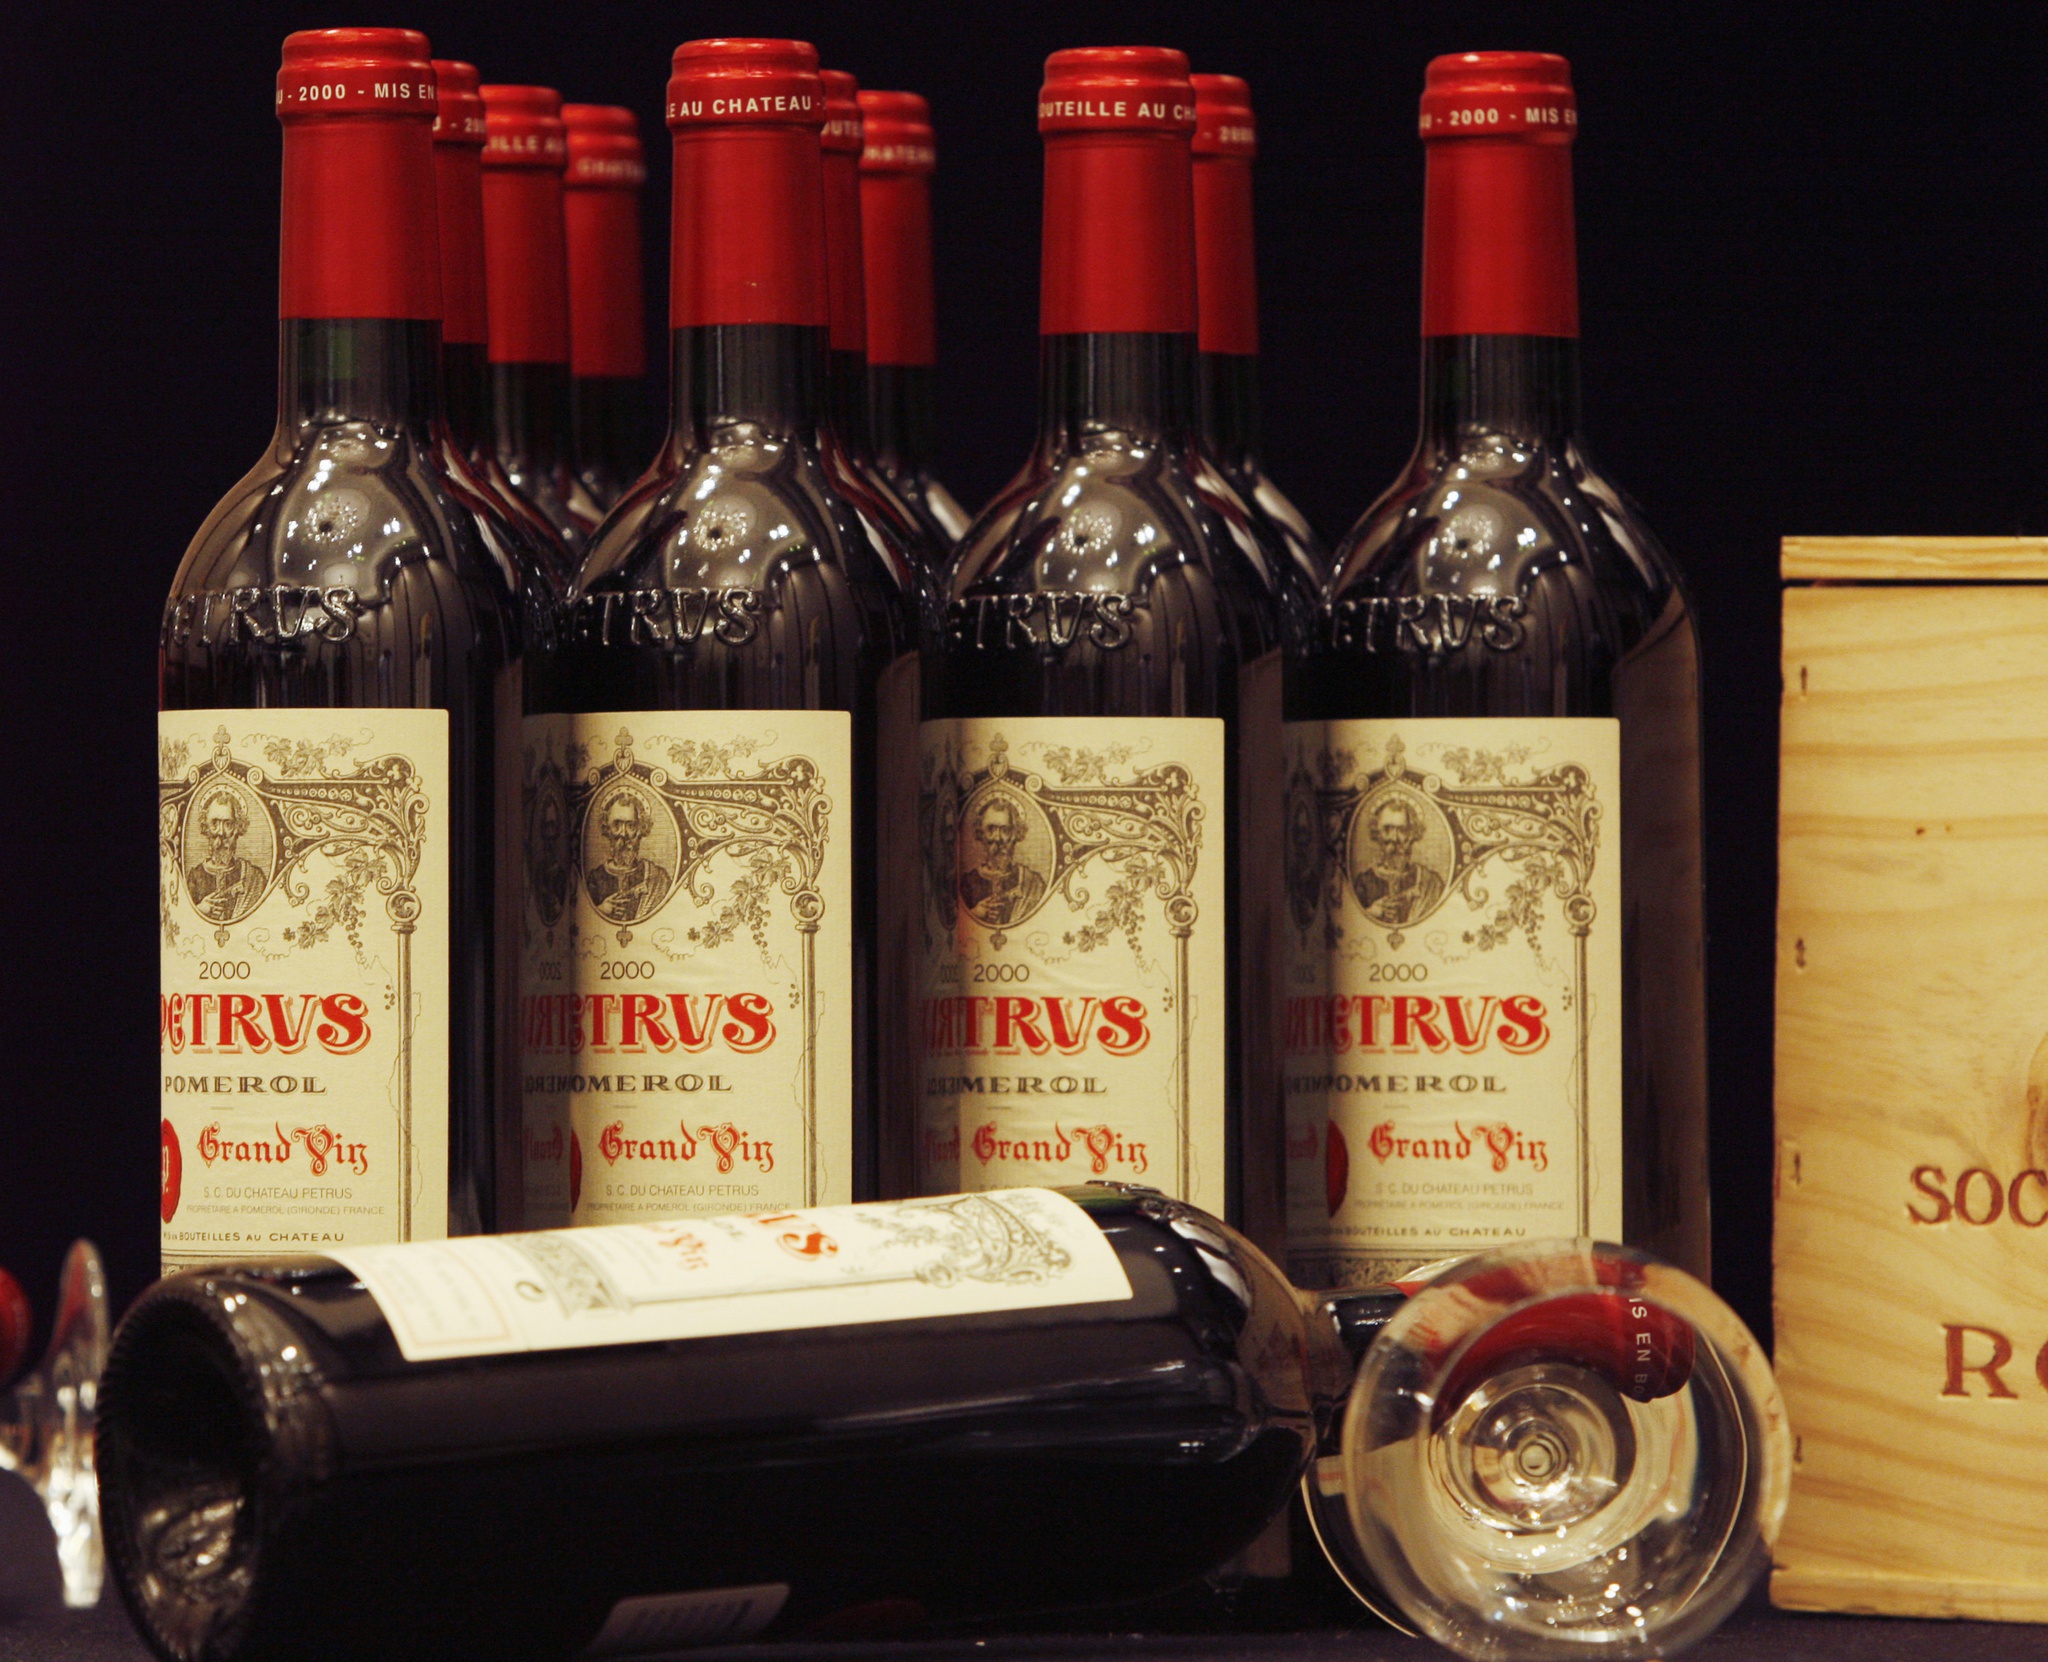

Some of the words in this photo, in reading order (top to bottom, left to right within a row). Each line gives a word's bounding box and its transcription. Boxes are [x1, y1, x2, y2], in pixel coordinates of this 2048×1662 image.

[299, 84, 346, 101] 2000
[374, 83, 411, 98] MIS
[680, 101, 703, 116] AU
[712, 96, 812, 115] CHATEAU
[1138, 102, 1166, 119] AU
[1450, 107, 1499, 126] 2000
[1525, 107, 1560, 125] MIS
[199, 961, 251, 980] 2000
[600, 961, 655, 980] 2000
[973, 963, 1030, 983] 2000
[1369, 963, 1428, 982] 2000
[165, 1075, 328, 1094] POMEROL
[197, 1120, 292, 1168] Grand
[291, 1123, 369, 1177] Vin
[598, 1119, 698, 1167] Grand
[697, 1121, 775, 1174] Vin
[972, 1121, 1072, 1167] Grand
[1071, 1124, 1149, 1175] Vin
[1368, 1119, 1471, 1165] Grand
[1472, 1121, 1549, 1173] Vin
[226, 1187, 242, 1199] DU
[244, 1187, 299, 1199] CHATEAU
[302, 1187, 353, 1199] PETRUS
[630, 1184, 646, 1197] DU
[649, 1184, 705, 1197] CHATEAU
[708, 1184, 760, 1197] PETRUS
[1402, 1182, 1419, 1195] DU
[1422, 1182, 1481, 1195] CHATEAU
[1483, 1182, 1534, 1195] PETRUS
[241, 1205, 284, 1214] POMEROL
[343, 1206, 385, 1215] FRANCE
[646, 1202, 690, 1212] POMEROL
[179, 1232, 241, 1241] BOUTEILLES
[246, 1234, 262, 1242] AU
[269, 1232, 345, 1242] CHATEAU
[1449, 1227, 1526, 1237] CHATEAU
[1636, 1332, 1651, 1362] EN
[1941, 1322, 2048, 1401] R
